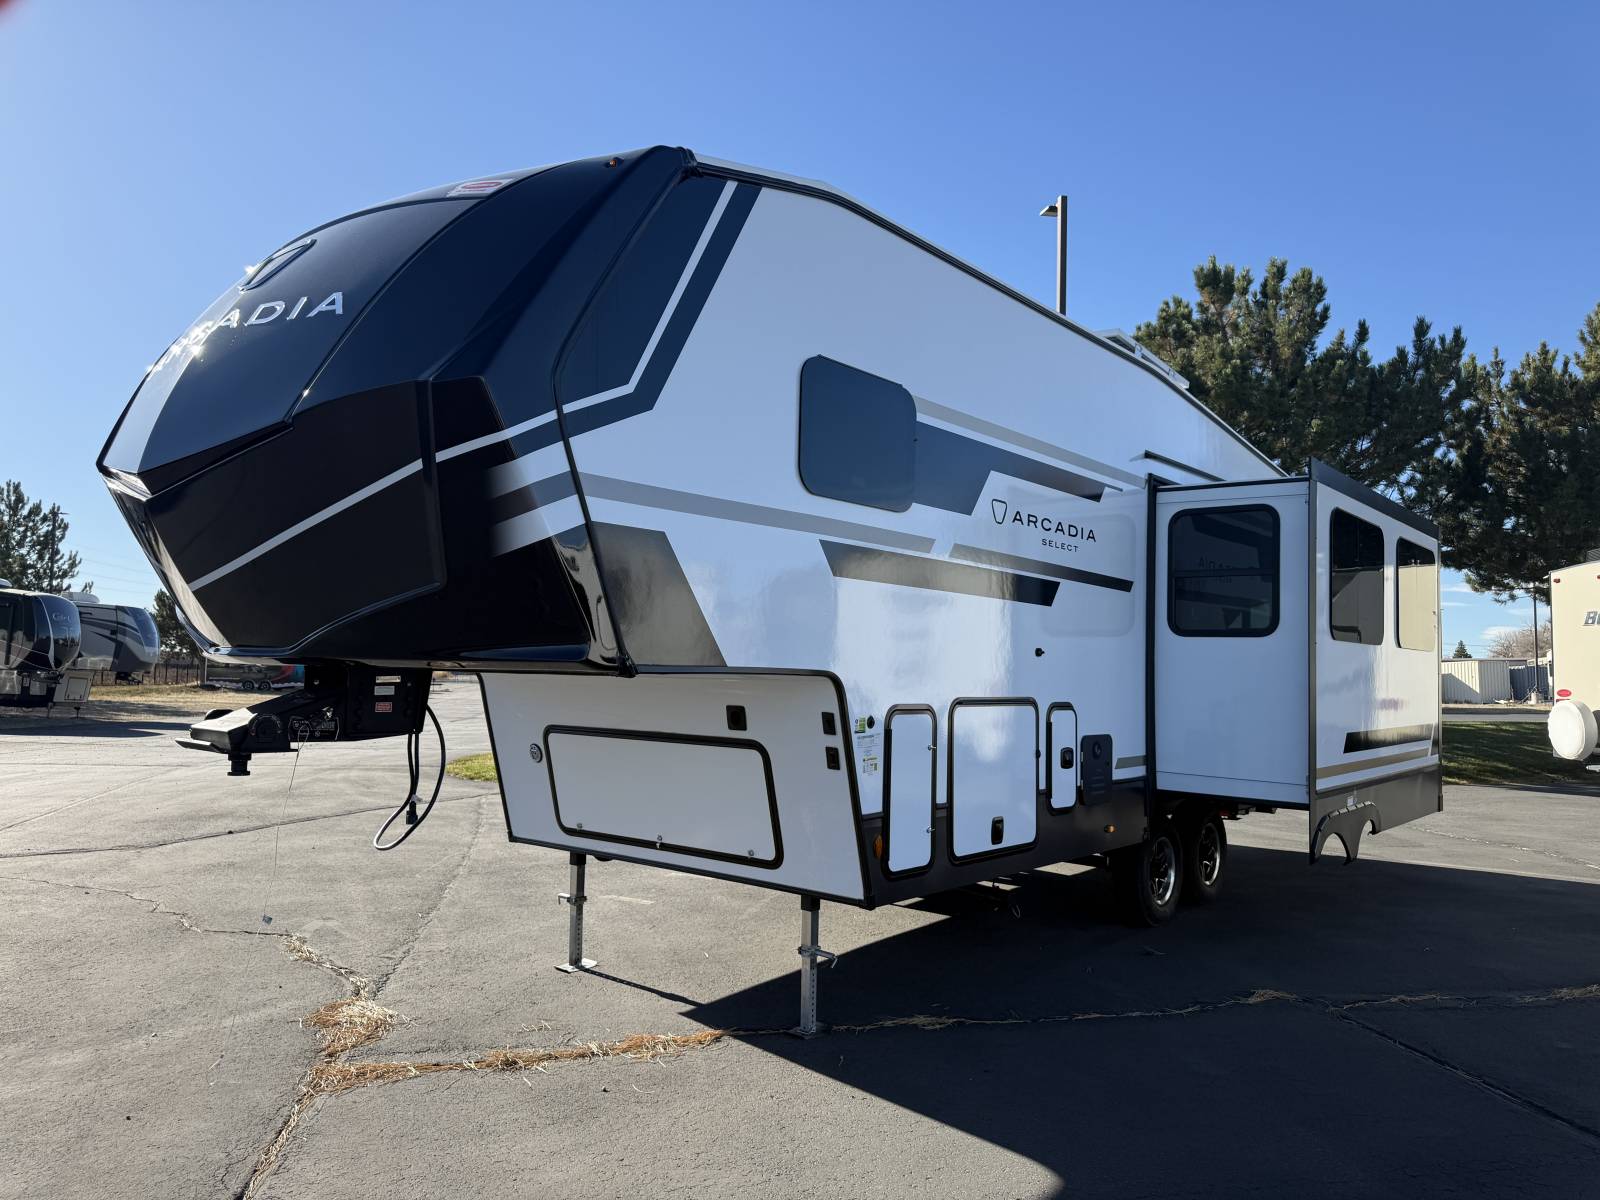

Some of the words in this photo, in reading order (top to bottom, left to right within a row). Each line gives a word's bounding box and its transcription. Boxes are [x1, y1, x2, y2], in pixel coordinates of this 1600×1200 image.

[1012, 511, 1096, 542] ARCADIA
[1042, 539, 1078, 552] SELECT
[1584, 611, 1600, 624] B
